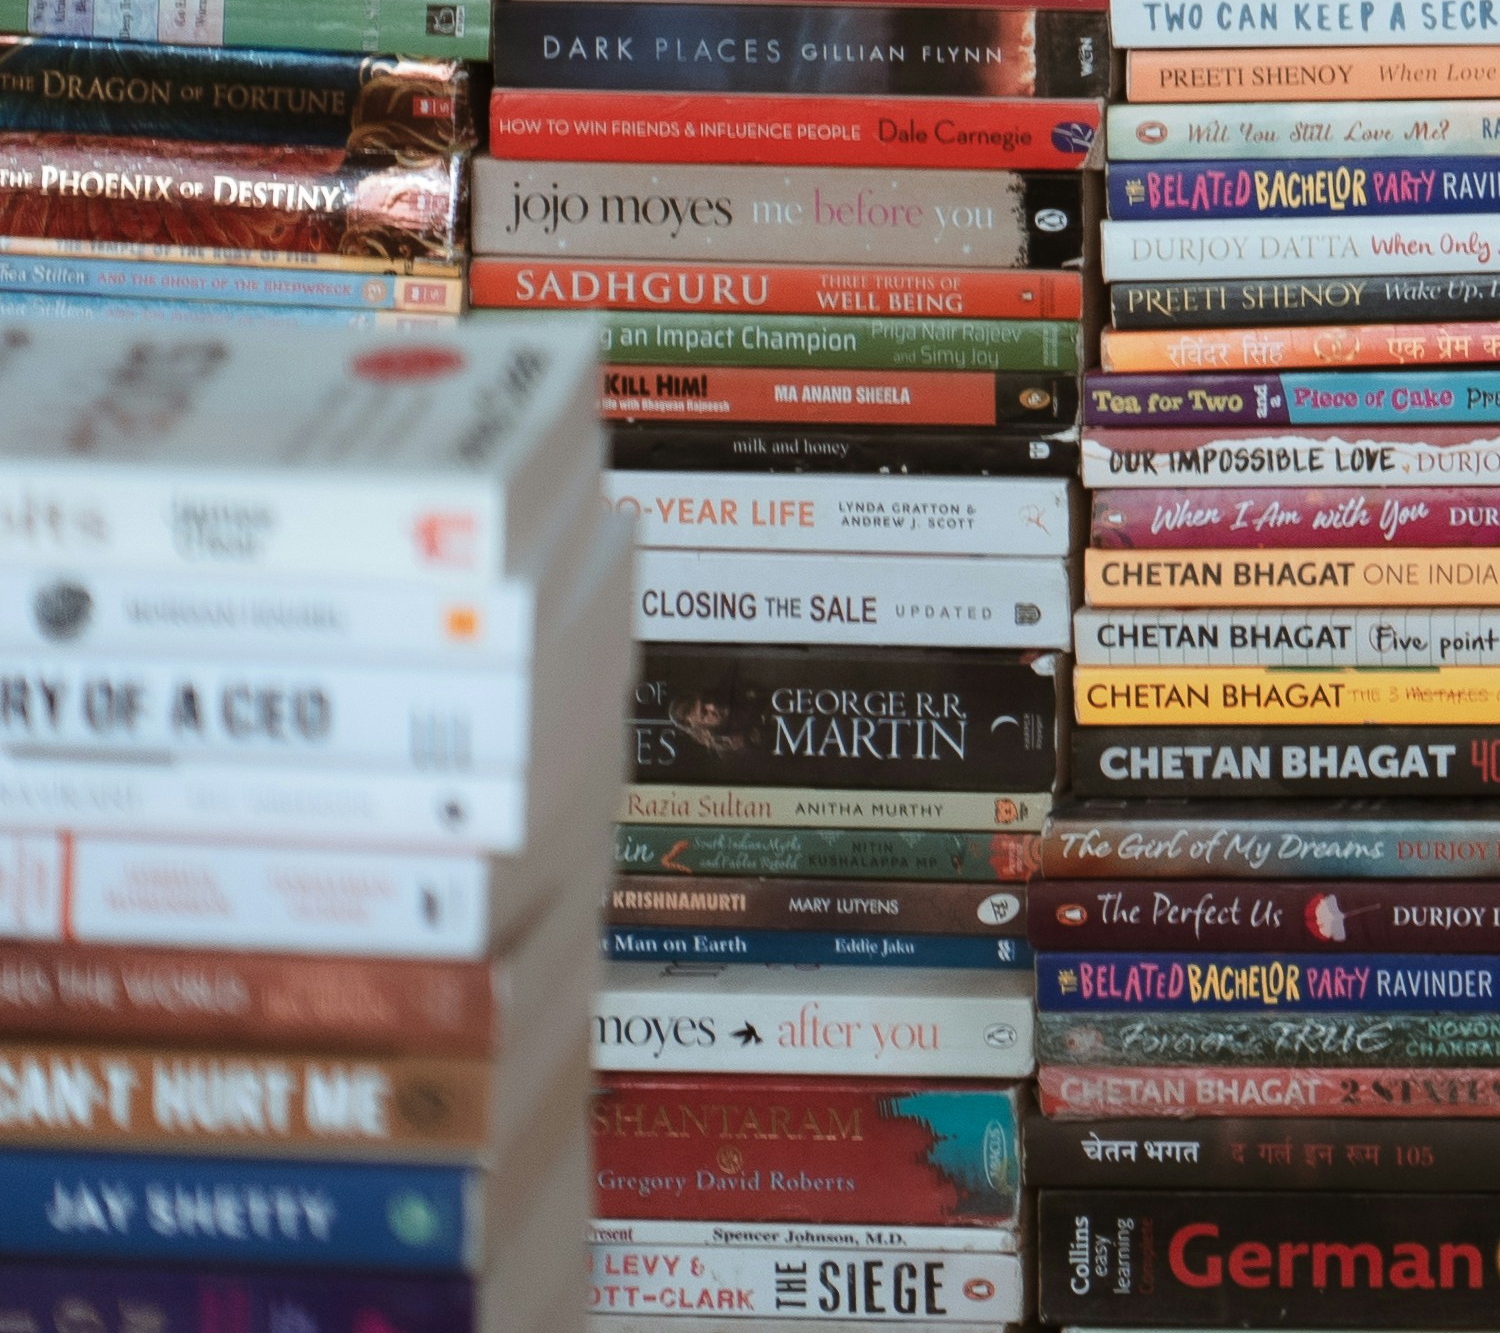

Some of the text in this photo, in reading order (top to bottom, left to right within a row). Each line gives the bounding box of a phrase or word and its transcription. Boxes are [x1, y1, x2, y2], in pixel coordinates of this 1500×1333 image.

[516, 270, 770, 306] SADHGURU
[643, 590, 877, 626] CLOSING THE SALE
[1166, 1226, 1482, 1292] German
[818, 1258, 947, 1316] SIEGE
